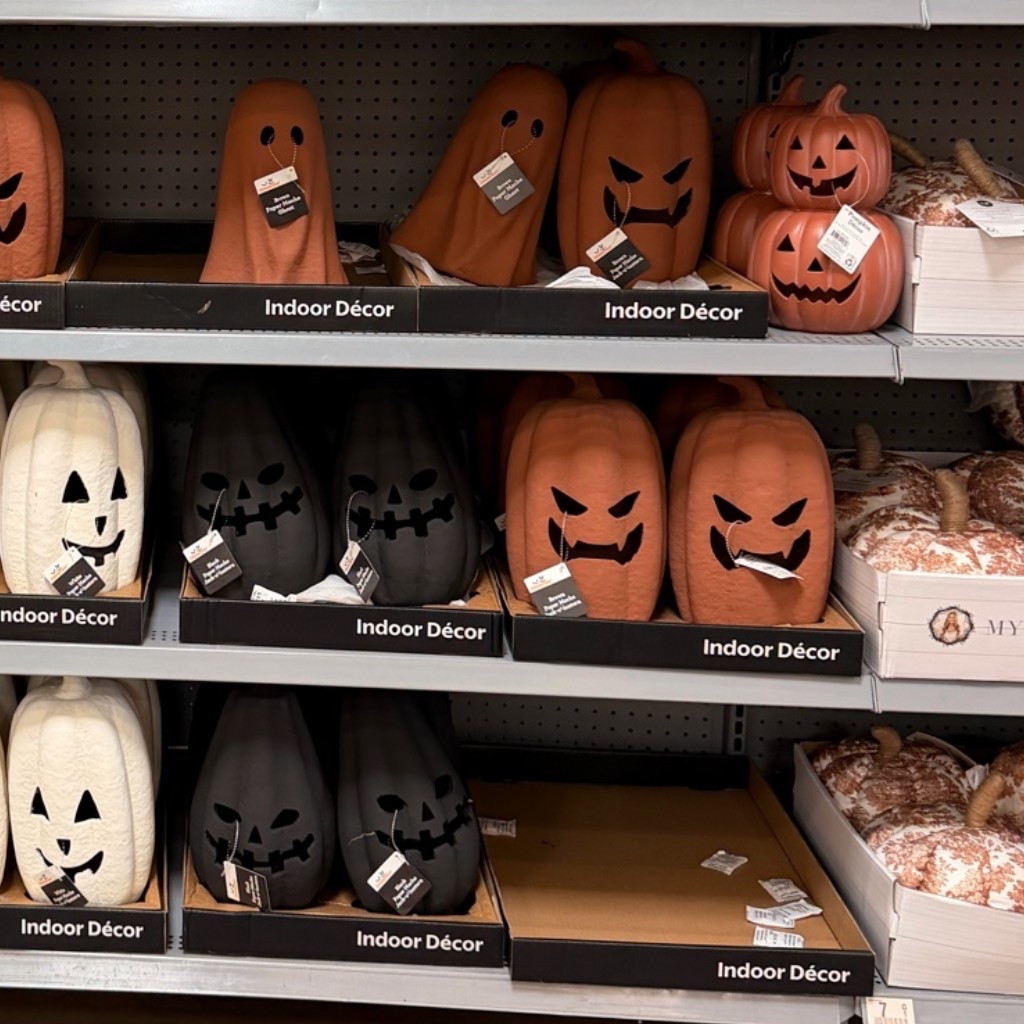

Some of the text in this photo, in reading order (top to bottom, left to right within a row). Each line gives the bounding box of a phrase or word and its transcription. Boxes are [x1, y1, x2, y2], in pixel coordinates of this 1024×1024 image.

[266, 299, 394, 317] Indoor Décor
[606, 302, 743, 320] Indoor Décor
[62, 608, 117, 626] Décor
[357, 619, 486, 640] Indoor Décor
[986, 619, 1023, 636] MY
[704, 639, 840, 661] Indoor Décor
[22, 919, 143, 938] Indoor Décor
[357, 931, 483, 952] Indoor Décor
[718, 962, 850, 983] Indoor Décor
